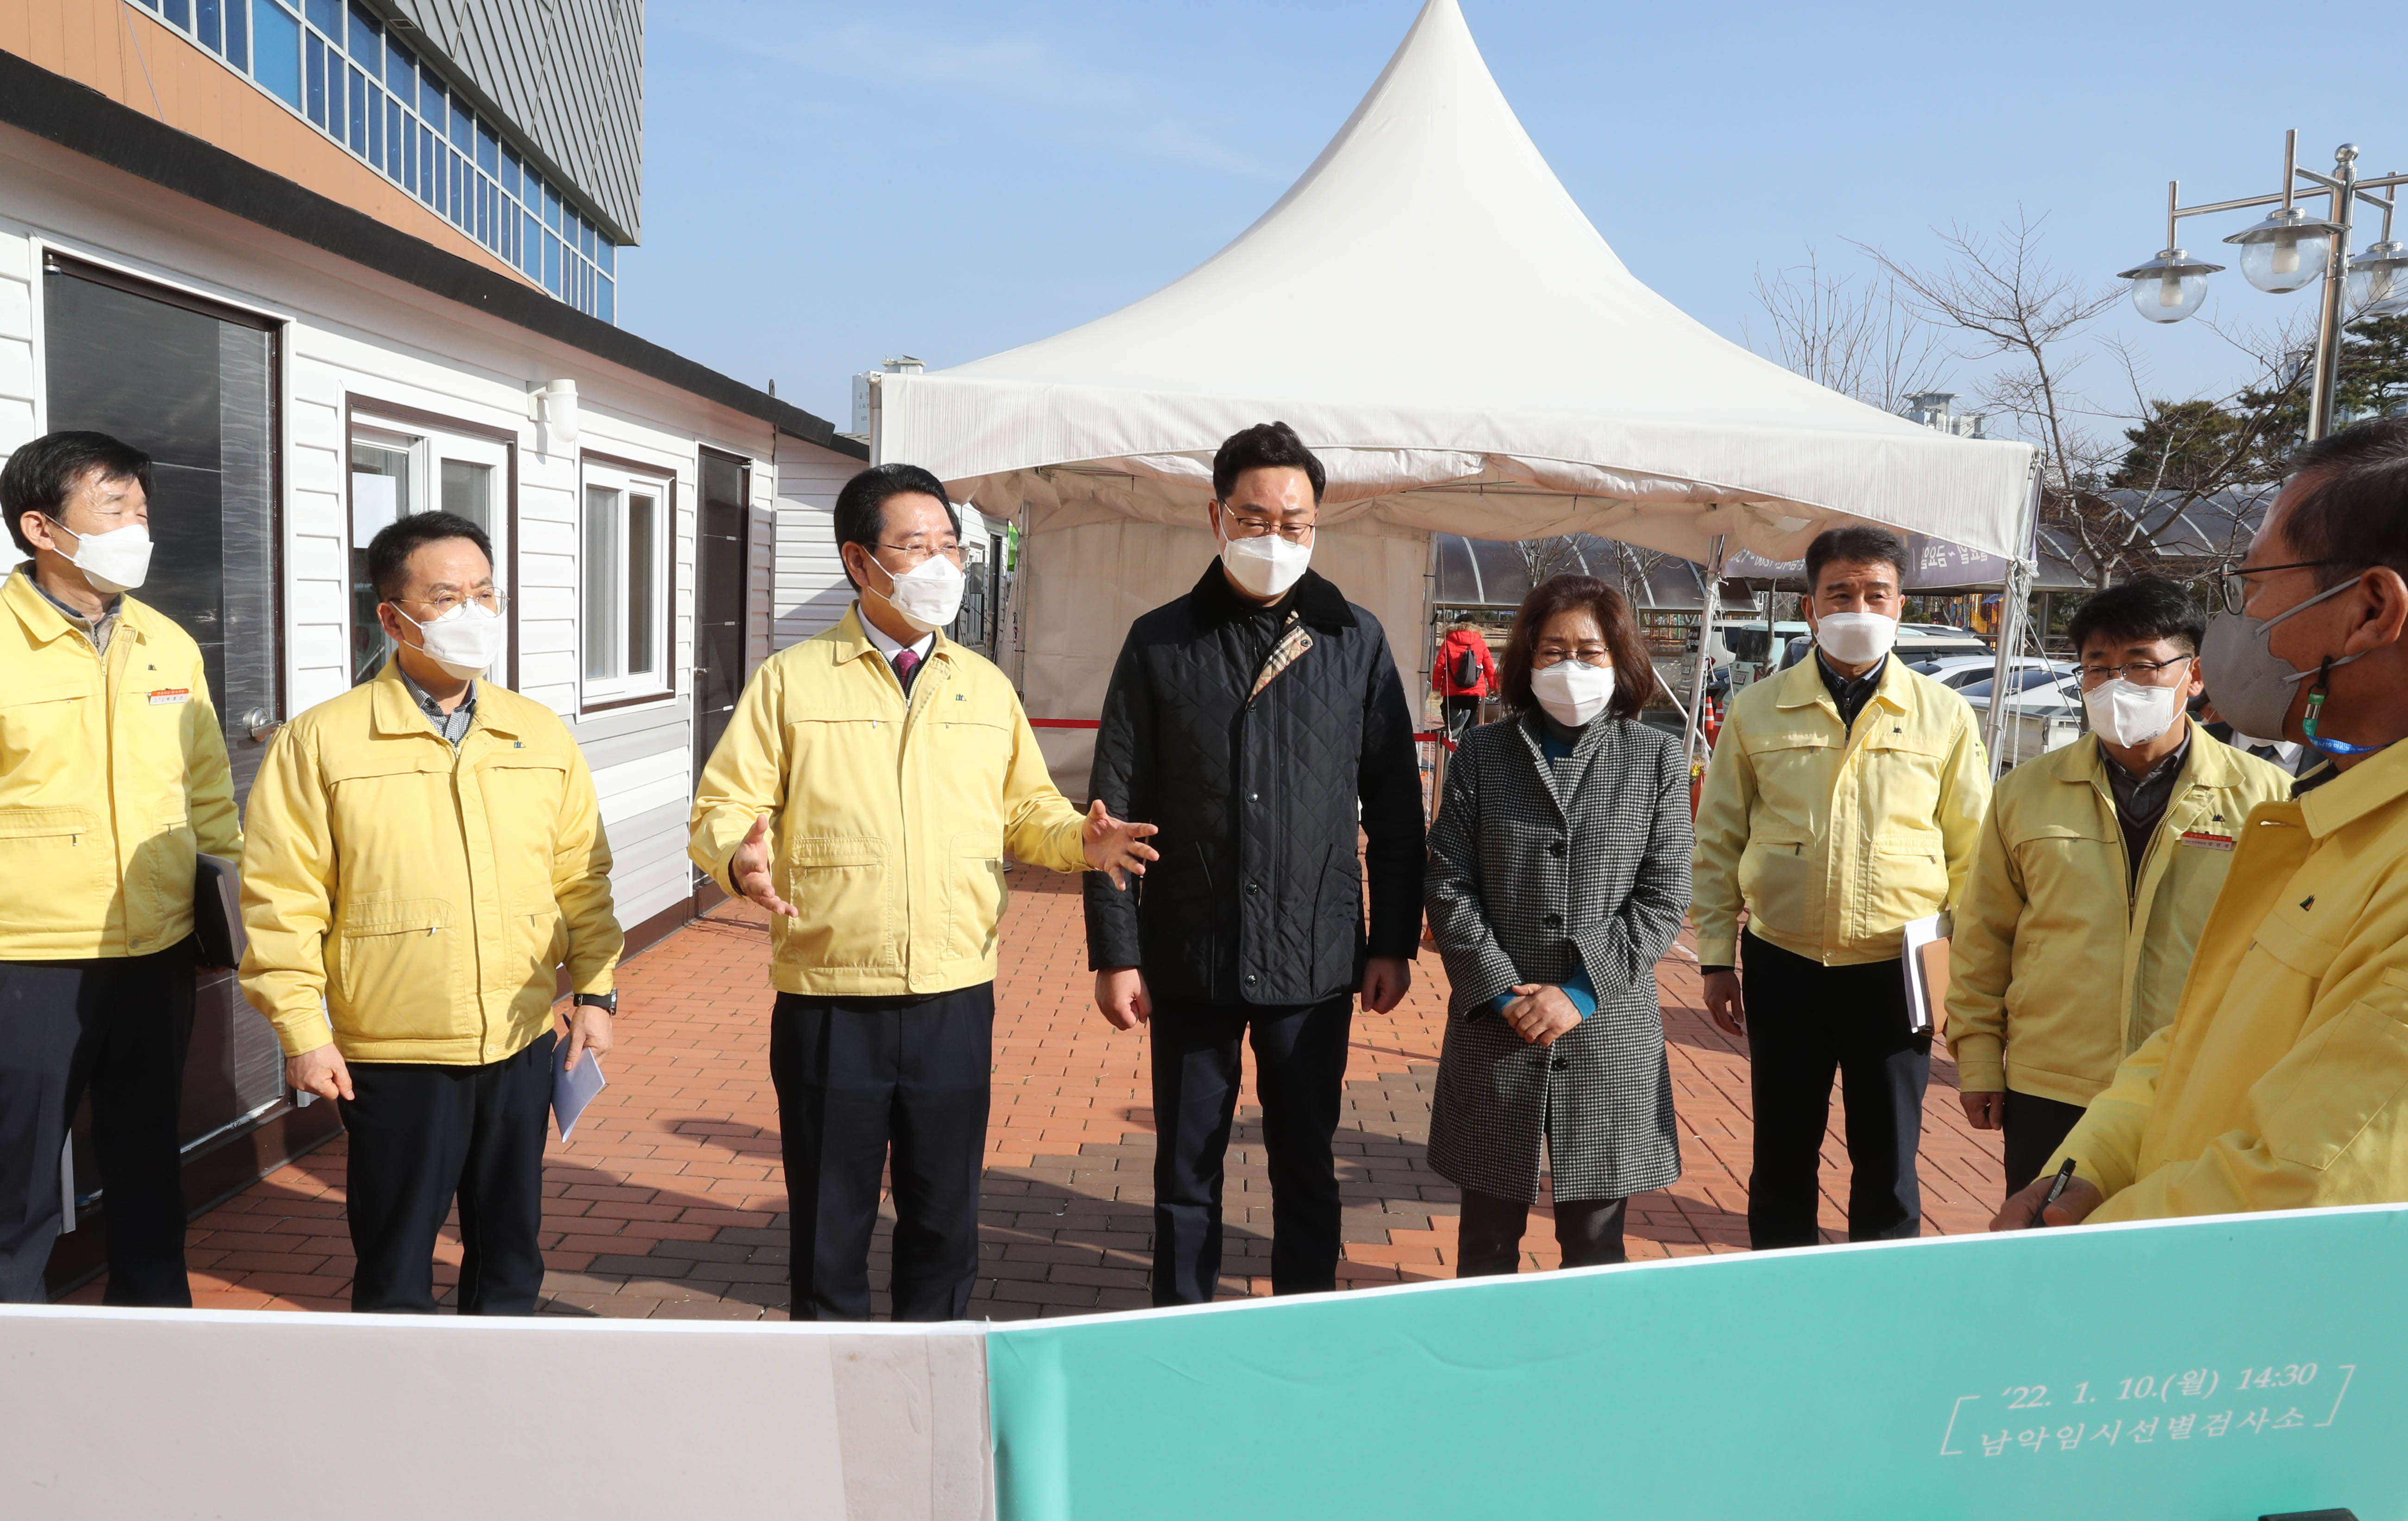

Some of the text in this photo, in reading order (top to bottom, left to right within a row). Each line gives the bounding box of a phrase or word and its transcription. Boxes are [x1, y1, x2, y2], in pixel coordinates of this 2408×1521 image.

[2072, 1381, 2095, 1404] 1.
[2237, 1362, 2318, 1390] 14:30
[1981, 1407, 2304, 1457] 남악임시선별검사소
